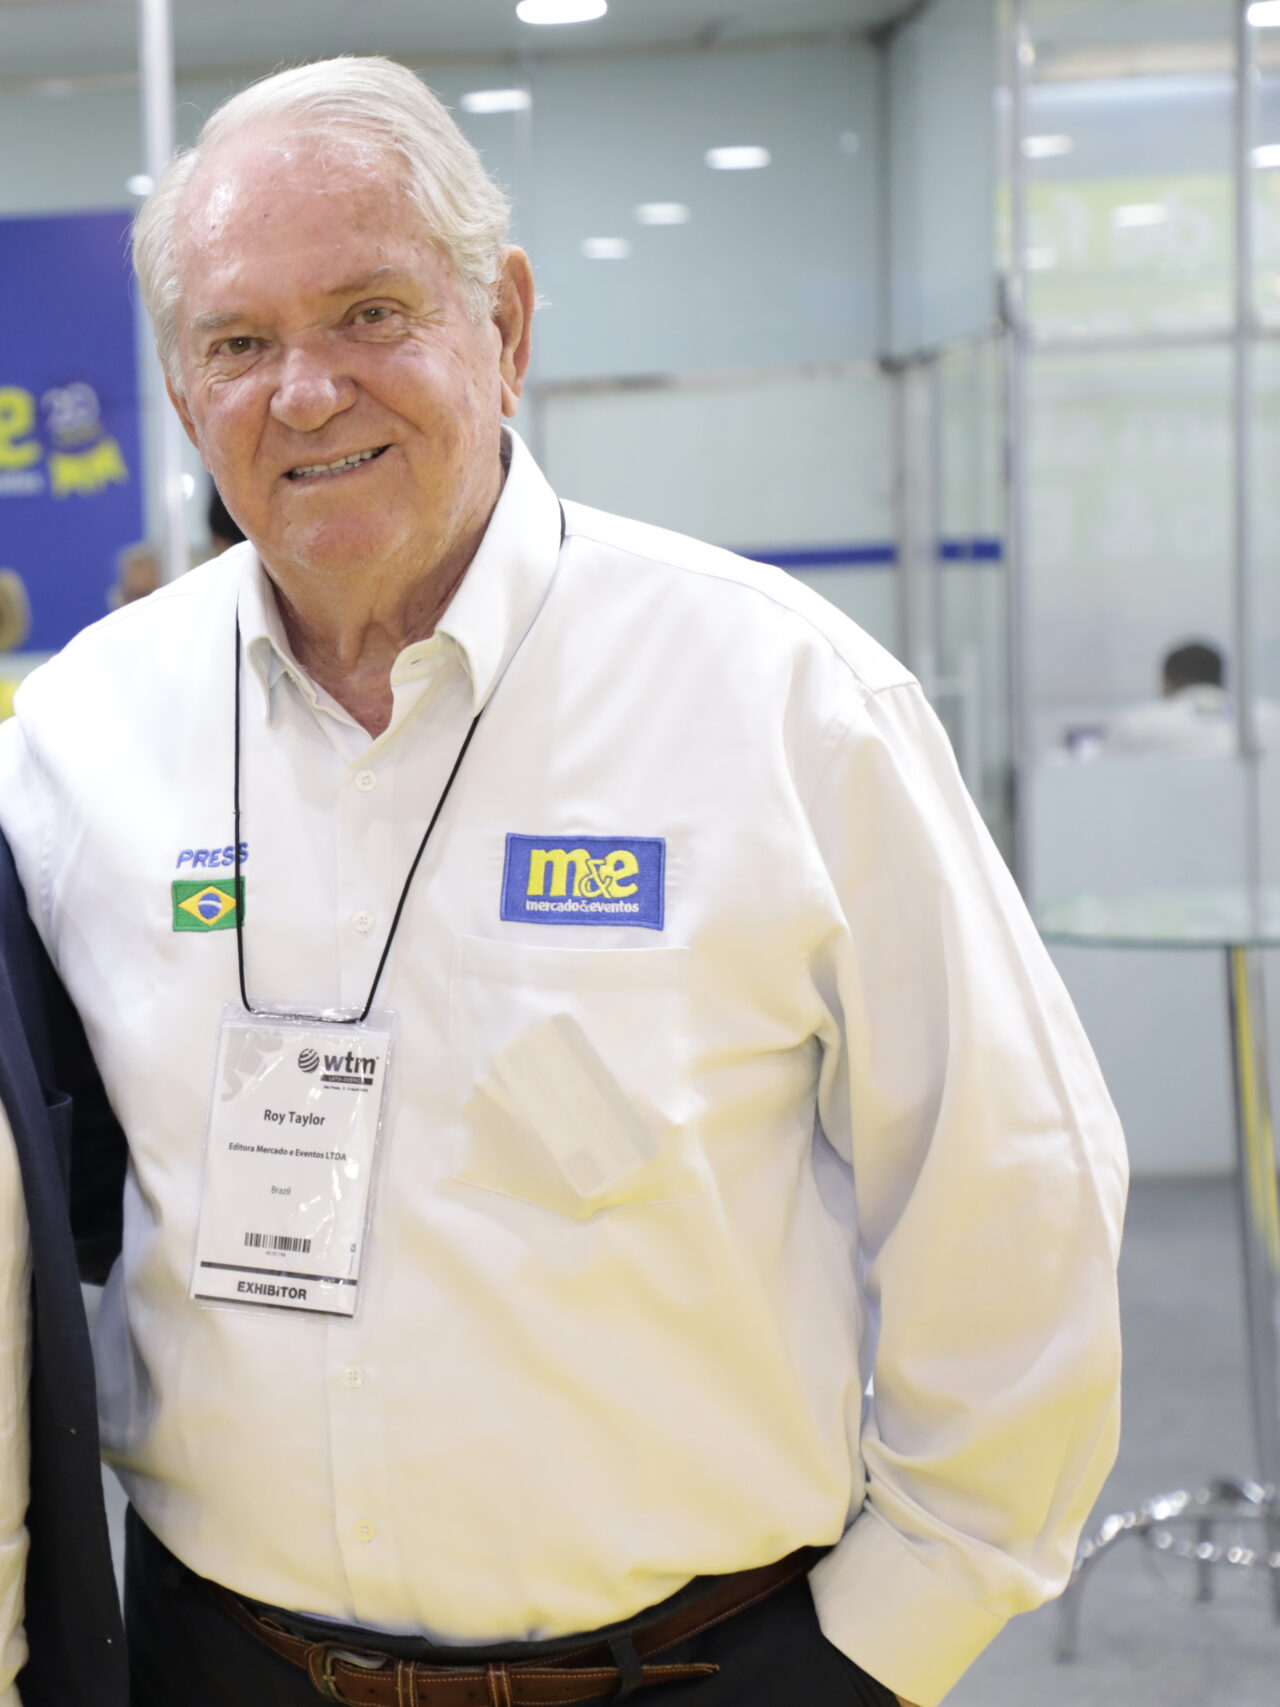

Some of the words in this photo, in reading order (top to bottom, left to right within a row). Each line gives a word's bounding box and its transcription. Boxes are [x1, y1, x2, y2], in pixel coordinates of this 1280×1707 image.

[175, 842, 249, 869] PRESS
[526, 848, 640, 899] m&e
[525, 898, 640, 914] mercado&eventos
[323, 1051, 376, 1075] wtm
[264, 1109, 286, 1125] Roy
[289, 1111, 326, 1127] Taylor
[228, 1142, 255, 1153] Editora
[256, 1145, 289, 1156] Mercado
[295, 1149, 325, 1160] Eventos
[325, 1151, 347, 1161] LTDA
[271, 1185, 292, 1196] Brazil
[237, 1280, 307, 1300] EXHIBITOR
